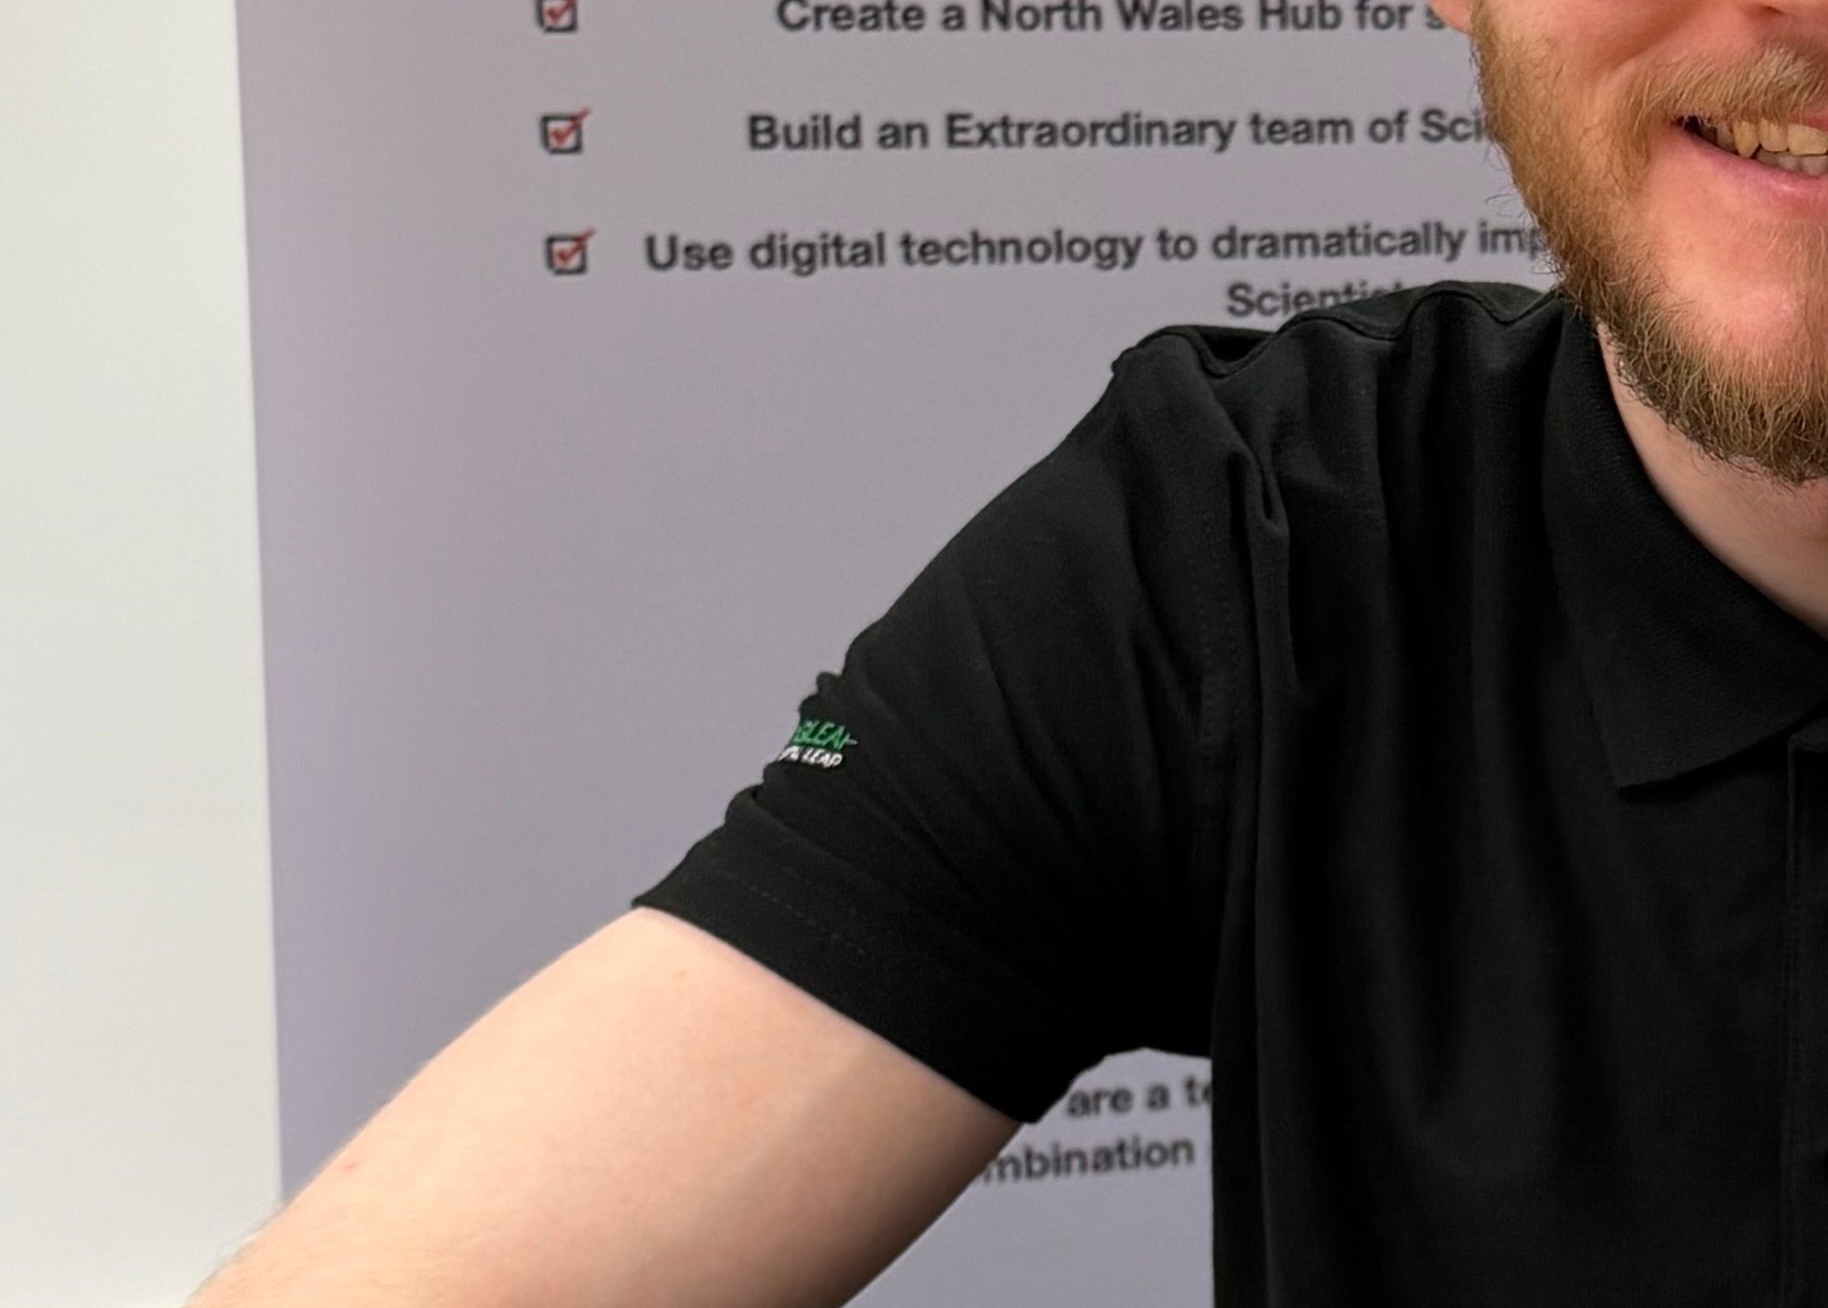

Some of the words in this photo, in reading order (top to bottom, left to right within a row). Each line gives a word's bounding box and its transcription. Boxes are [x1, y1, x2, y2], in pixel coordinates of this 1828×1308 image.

[941, 2, 967, 32] a
[747, 113, 862, 151] Build
[878, 119, 930, 150] an
[945, 110, 1237, 154] Extraordinary
[1249, 112, 1355, 145] team
[1368, 109, 1409, 143] of
[1420, 108, 1484, 143] Sci
[644, 232, 735, 272] Use
[748, 230, 888, 278] digital
[899, 227, 1144, 272] technology
[1157, 227, 1199, 262] to
[1211, 221, 1467, 264] dramatically
[1478, 219, 1545, 262] imp
[1064, 1084, 1135, 1118] are
[1146, 1082, 1171, 1111] a
[982, 1133, 1196, 1184] mbination
